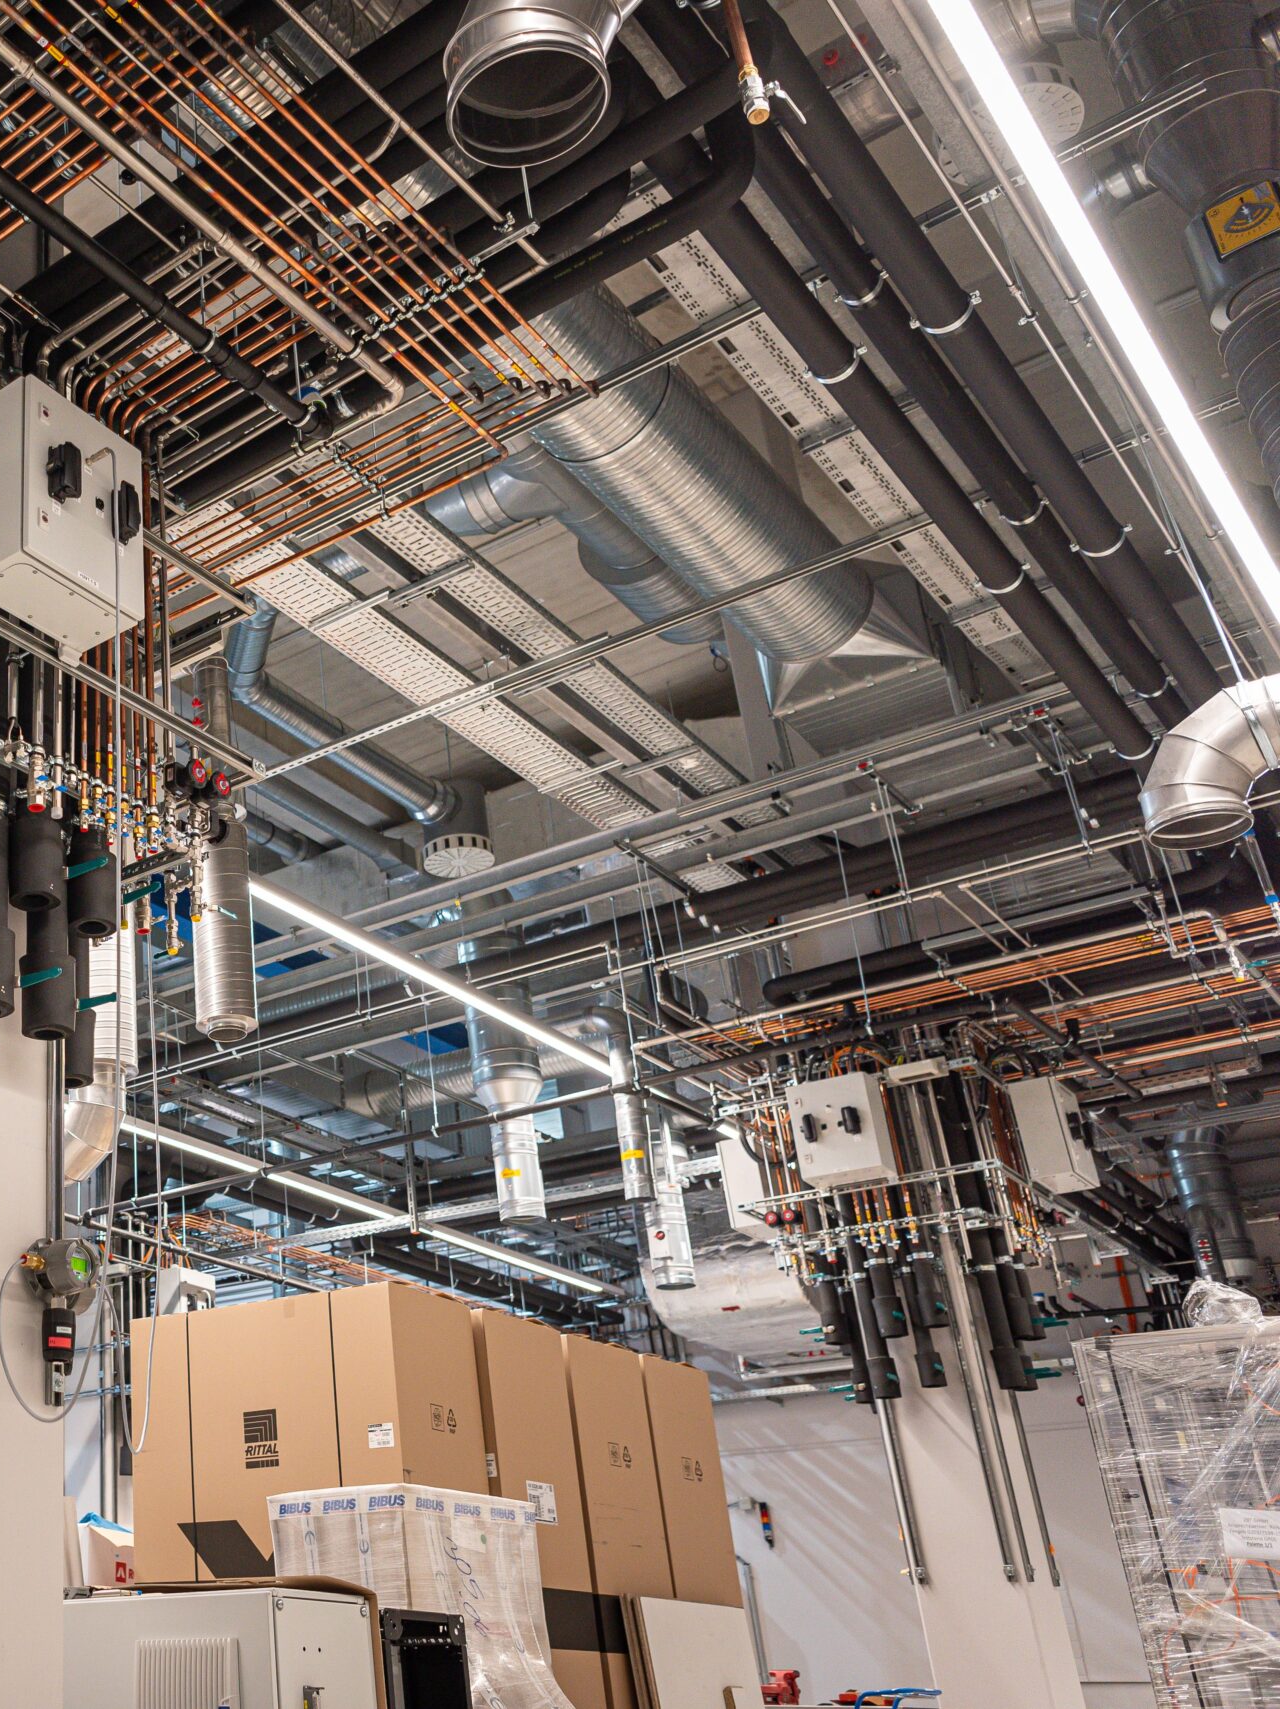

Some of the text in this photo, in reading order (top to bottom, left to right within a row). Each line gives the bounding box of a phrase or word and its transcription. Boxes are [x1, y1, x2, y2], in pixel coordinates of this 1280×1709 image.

[245, 1443, 279, 1456] RITTAL
[279, 1494, 406, 1515] BIBUS BIBUS BIBUS
[415, 1496, 445, 1512] BIBUS
[454, 1502, 481, 1517] BIBUS
[490, 1507, 516, 1521] BIBUS
